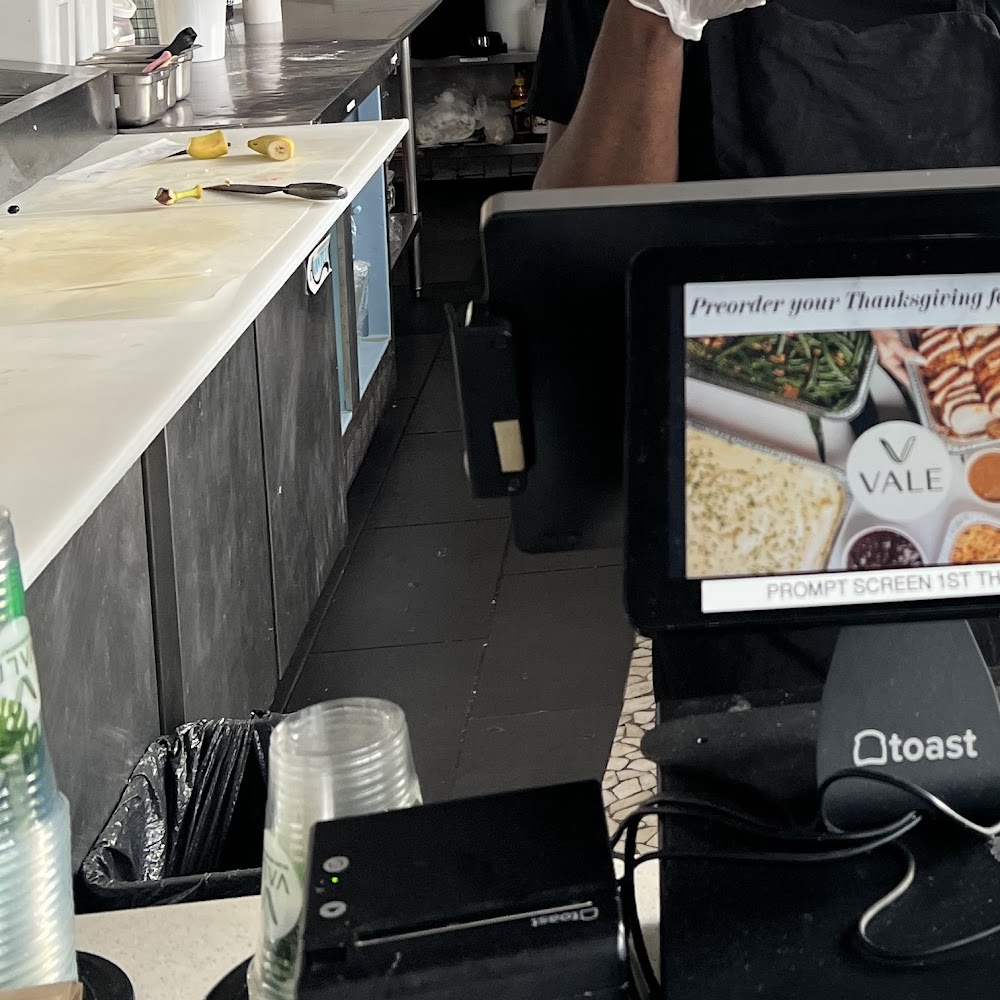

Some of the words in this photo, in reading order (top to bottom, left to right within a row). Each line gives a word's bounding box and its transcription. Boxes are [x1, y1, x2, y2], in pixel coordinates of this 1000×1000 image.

[690, 294, 785, 318] Preorder
[788, 296, 841, 320] your
[845, 288, 984, 316] Thanksgiving
[860, 467, 944, 494] VALE
[767, 578, 850, 601] PROMPT
[852, 574, 932, 596] SCREEN
[938, 571, 971, 591] 1ST
[888, 728, 978, 763] toast
[530, 910, 579, 928] toast
